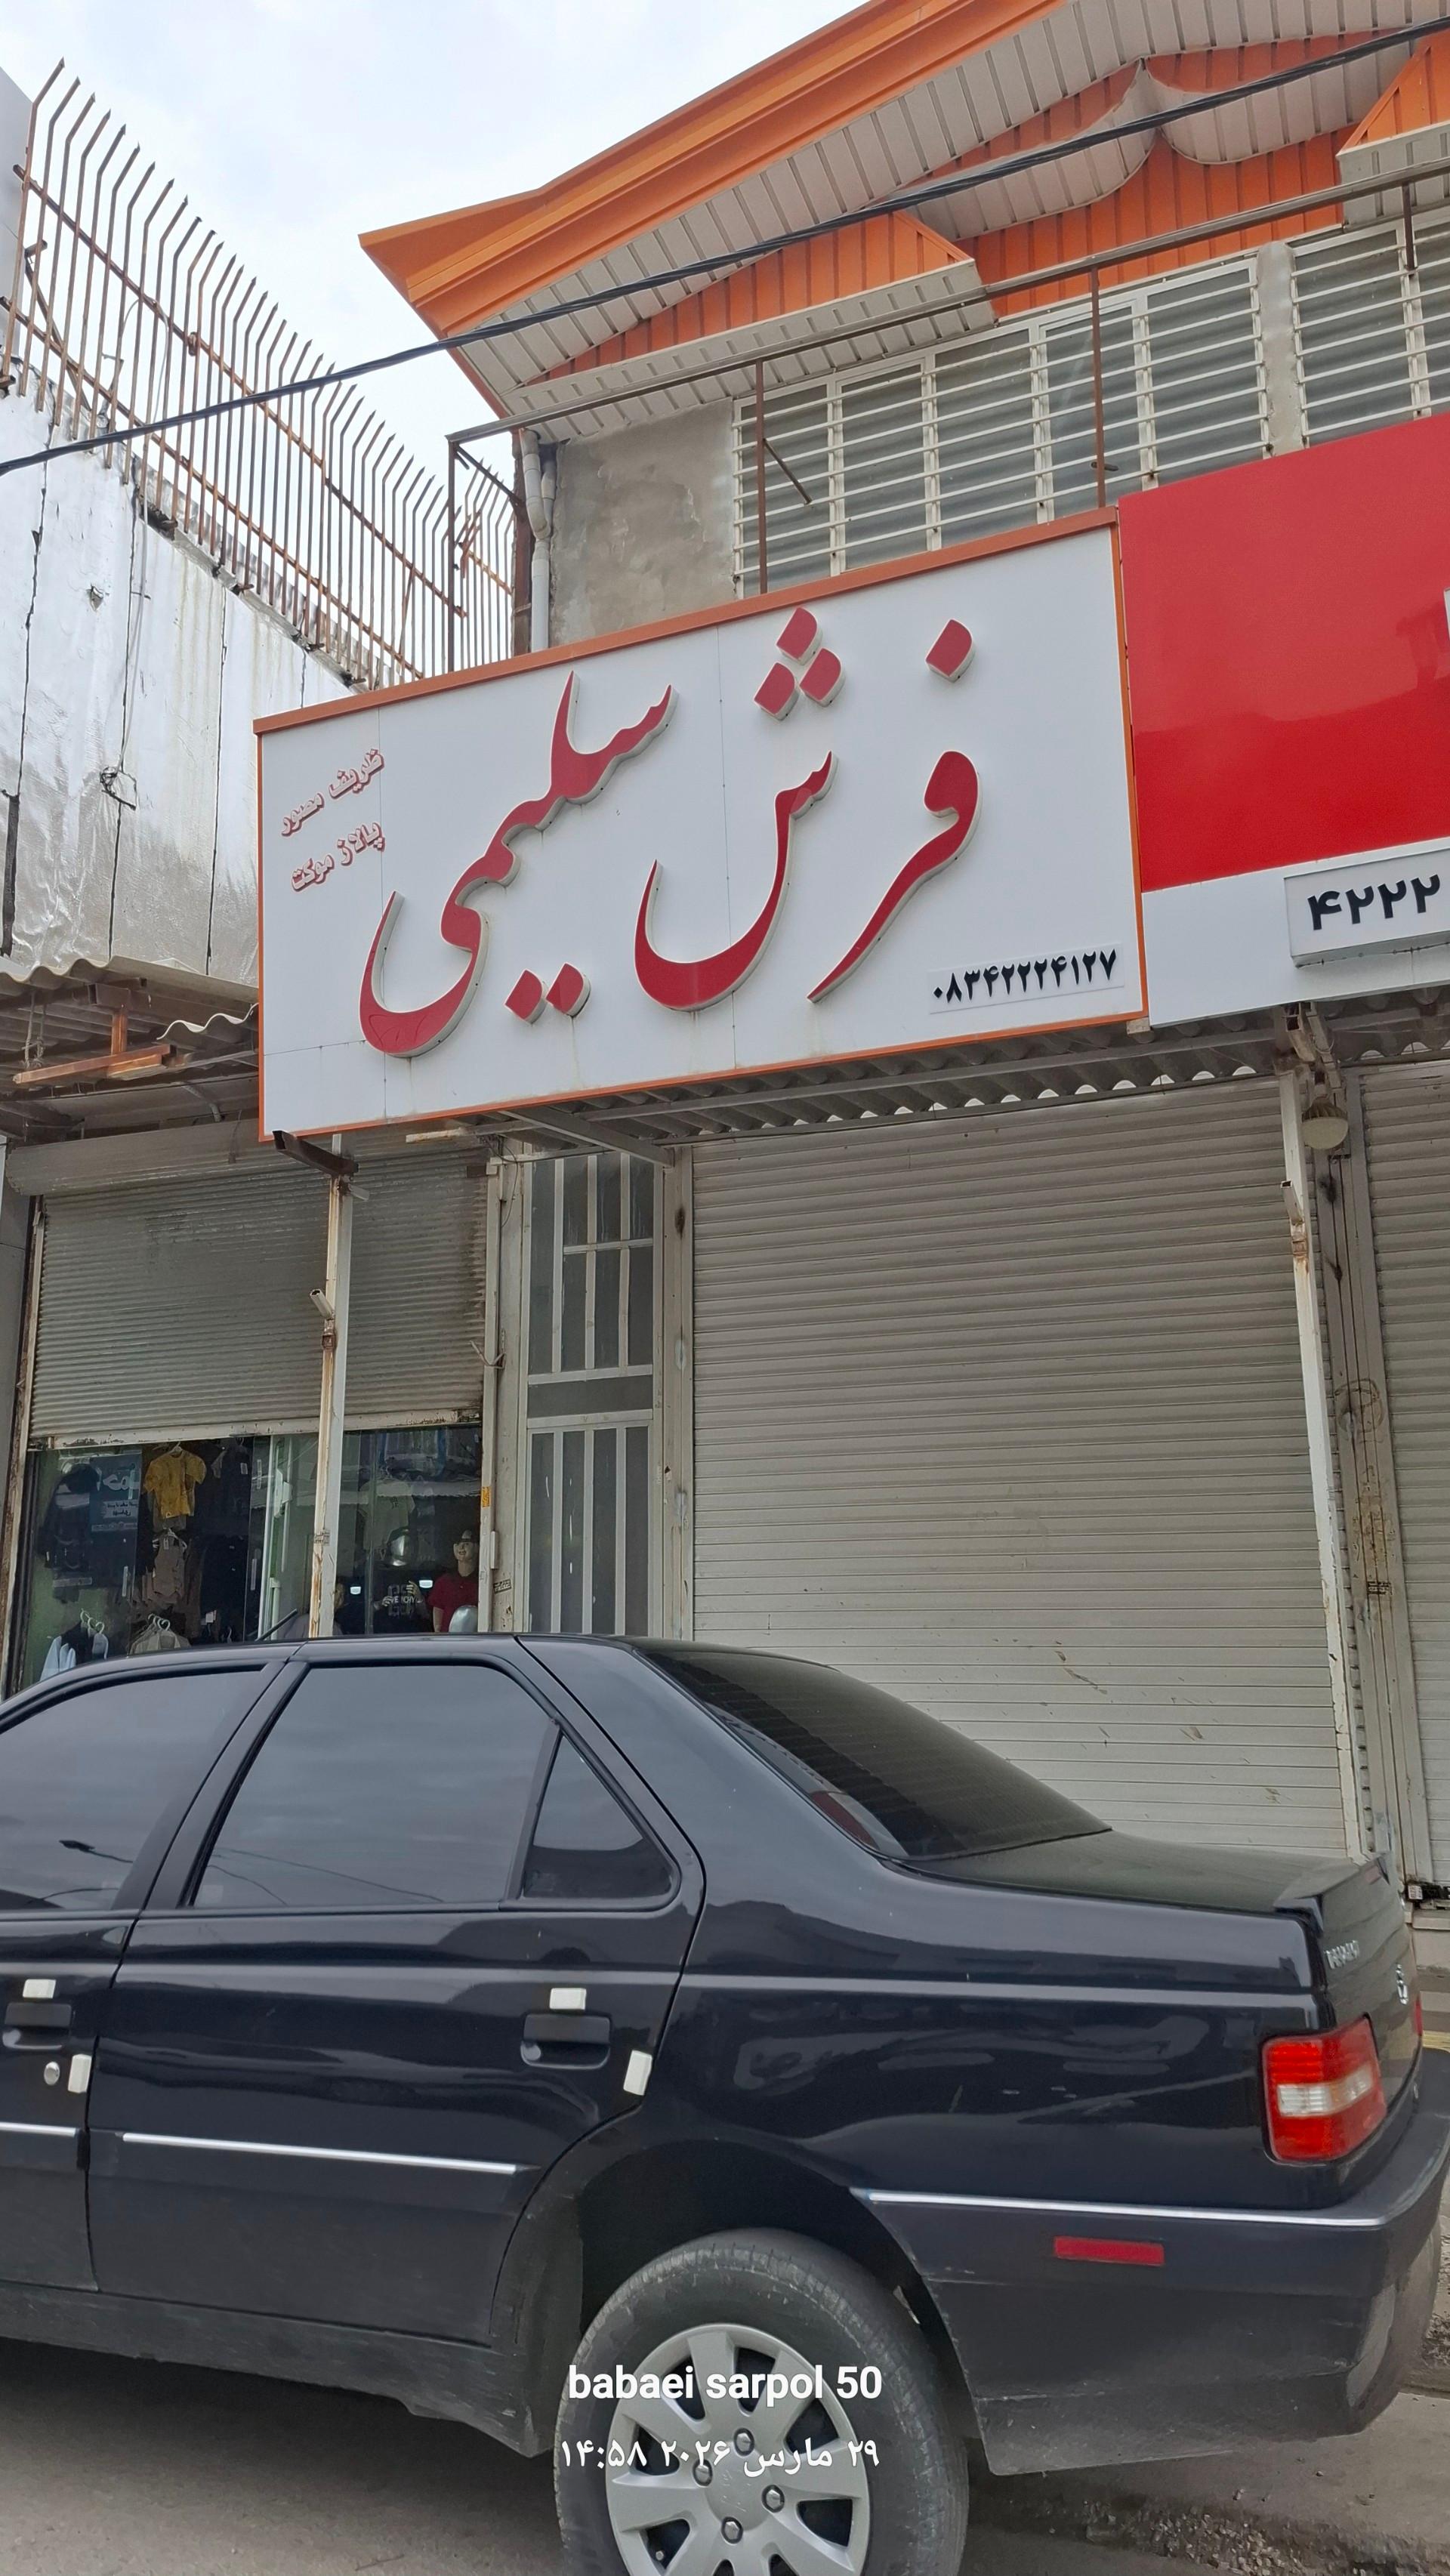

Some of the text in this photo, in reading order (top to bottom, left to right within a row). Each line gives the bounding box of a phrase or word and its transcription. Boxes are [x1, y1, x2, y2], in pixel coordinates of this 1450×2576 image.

[281, 748, 384, 837] ظریف مصور
[359, 606, 983, 1058] فرش سلیمی
[292, 855, 335, 892] موکت
[933, 949, 1117, 1003] ۰۸۳۴۲۲۲۴۱۲۷
